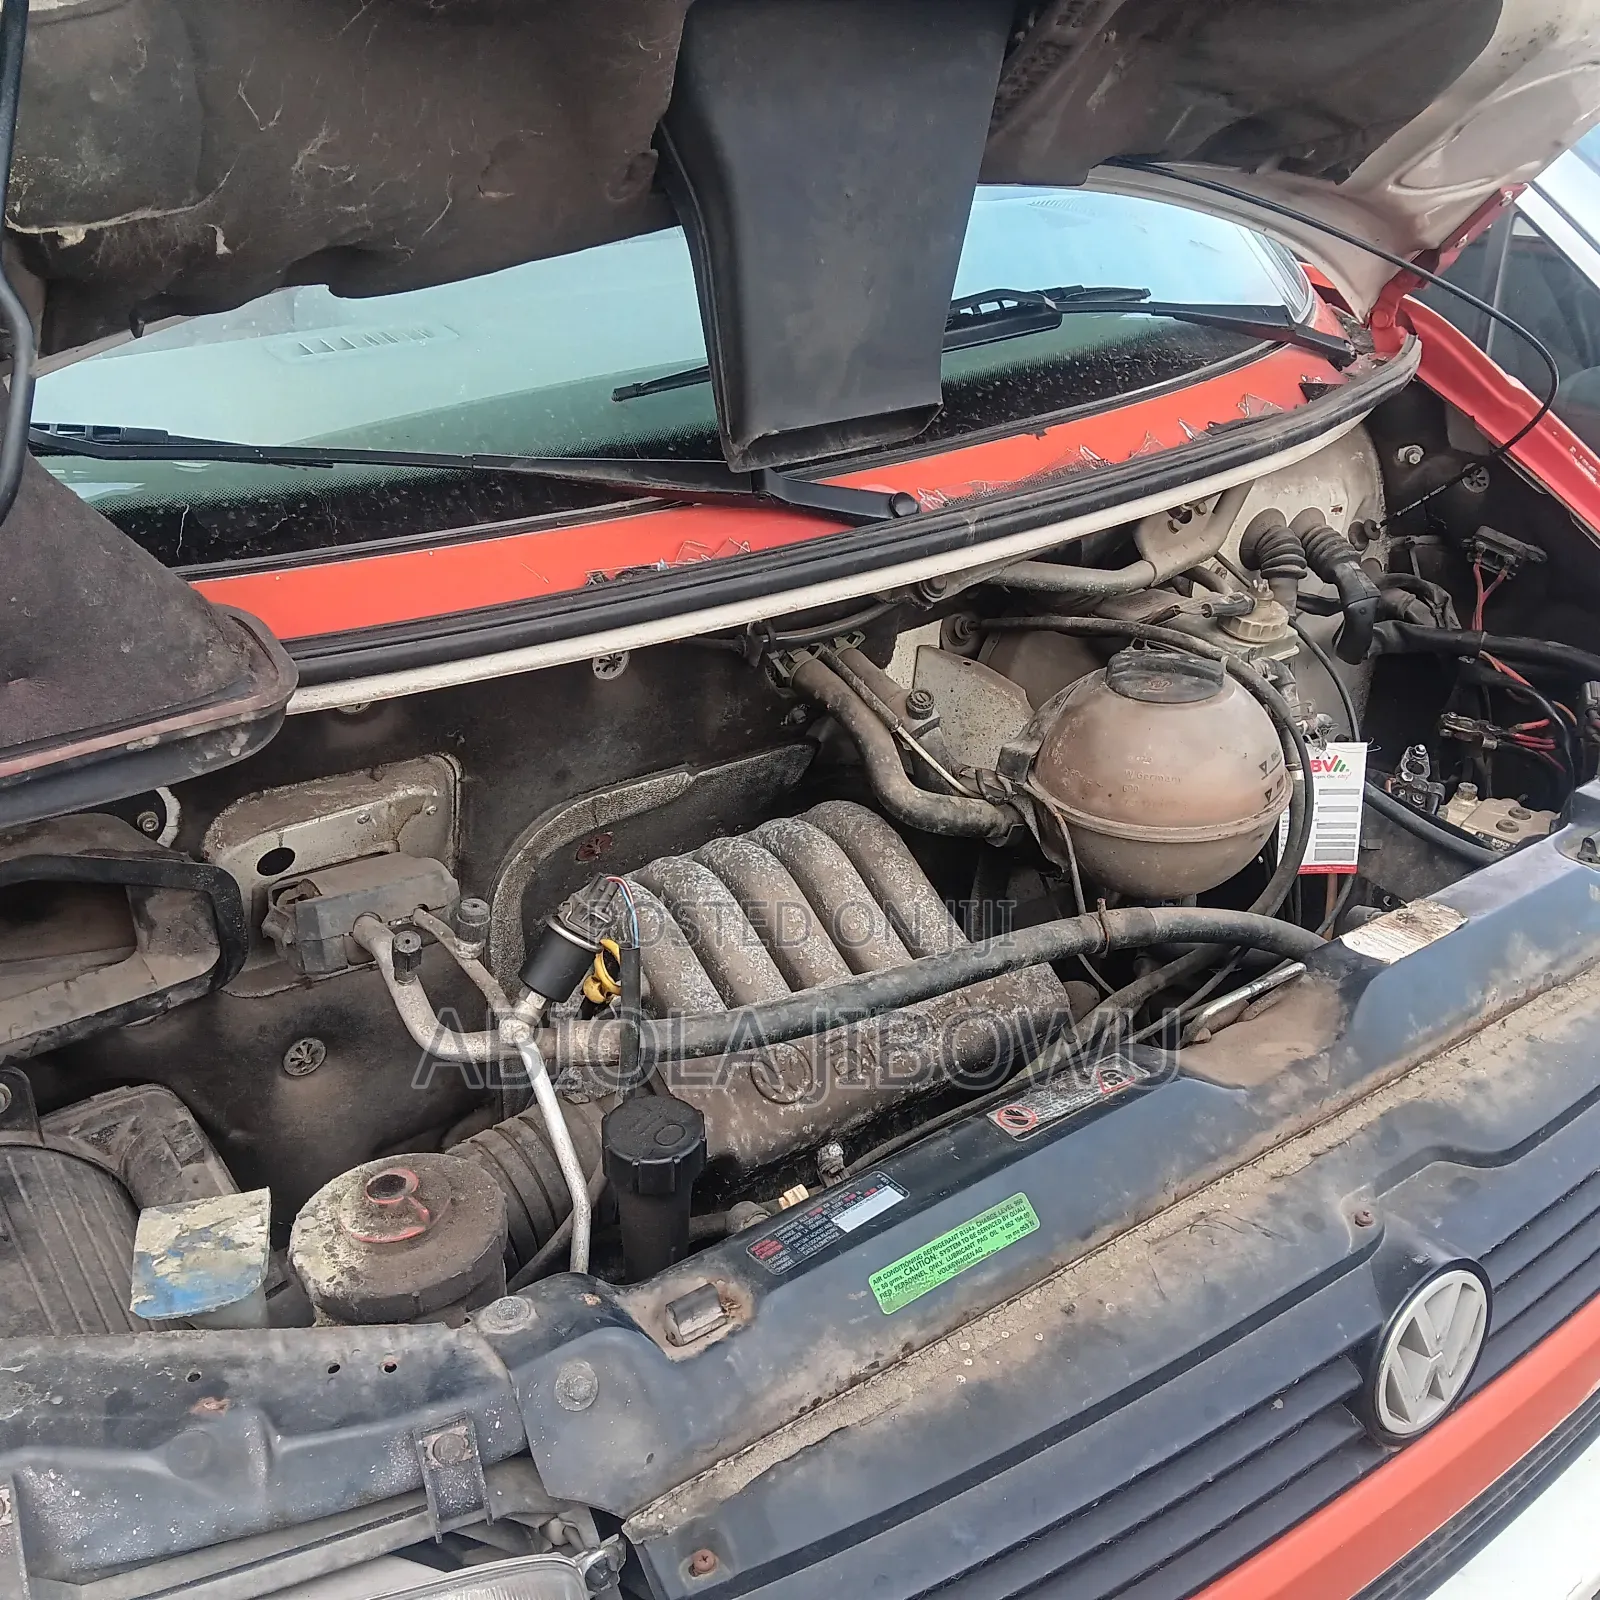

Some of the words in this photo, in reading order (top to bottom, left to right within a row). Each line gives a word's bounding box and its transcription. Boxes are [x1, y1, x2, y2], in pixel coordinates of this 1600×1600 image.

[1491, 838, 1511, 850] BOSCH
[778, 1229, 796, 1241] CHANGE
[803, 1213, 822, 1226] TOOTHED
[783, 1231, 803, 1244] CHANGER
[871, 1275, 883, 1285] AIR
[882, 1252, 923, 1280] CONDITIONING
[922, 1232, 959, 1257] REFRIGERANT
[975, 1211, 998, 1227] CHARGE
[997, 1202, 1014, 1215] LEVEL
[902, 1251, 939, 1277] CAUTION:
[938, 1240, 961, 1257] SYSTEM
[960, 1235, 970, 1244] TO
[968, 1231, 977, 1240] BE
[976, 1217, 1002, 1236] SERVICED
[1001, 1213, 1010, 1221] BY
[878, 1288, 893, 1300] FIED
[893, 1268, 928, 1292] PERSONNEL
[945, 1240, 976, 1262] LUBRICANT
[976, 1234, 988, 1244] PAG
[988, 1228, 998, 1237] OIL
[936, 1250, 975, 1276] VOLKSWAGEN
[973, 1246, 983, 1255] AG
